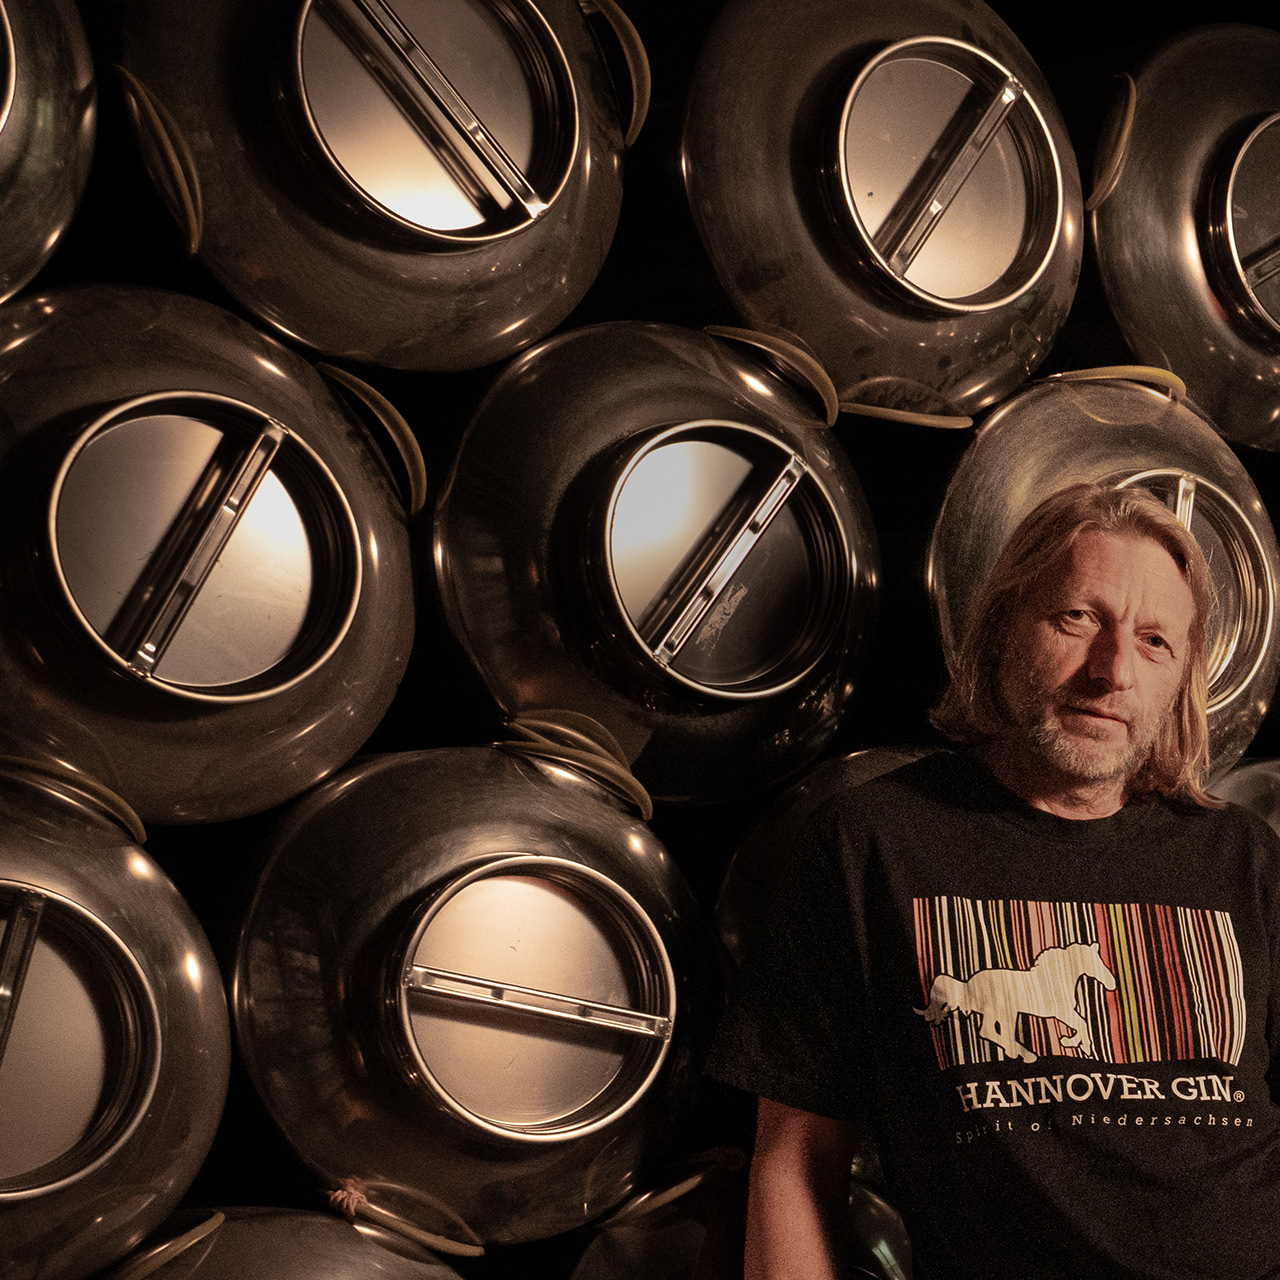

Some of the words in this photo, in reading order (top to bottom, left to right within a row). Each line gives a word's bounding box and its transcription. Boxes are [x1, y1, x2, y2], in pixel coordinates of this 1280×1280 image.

[955, 1073, 1165, 1112] HANNOVER
[955, 1119, 1014, 1145] Spirit
[1071, 1114, 1254, 1128] Niedersachsen
